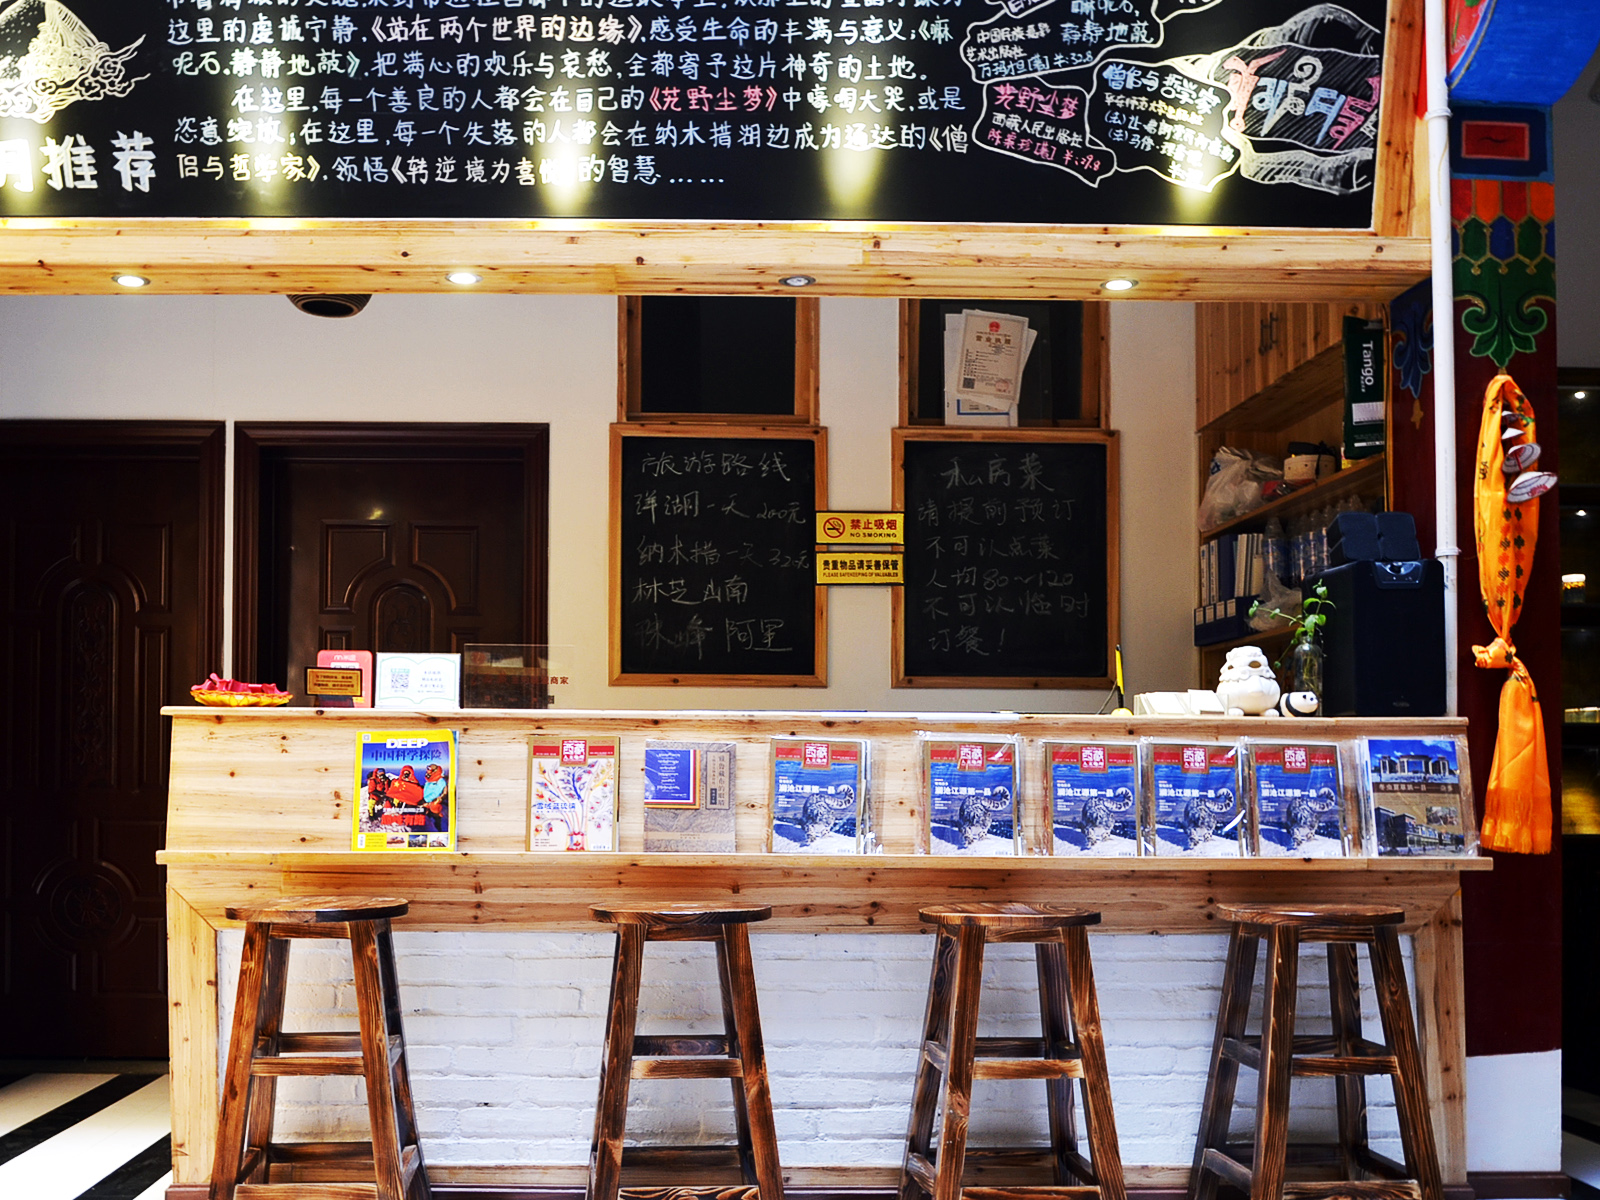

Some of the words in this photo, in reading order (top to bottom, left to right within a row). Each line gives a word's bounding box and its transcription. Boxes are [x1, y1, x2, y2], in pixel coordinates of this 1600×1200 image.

[1362, 340, 1375, 386] Tango
[642, 451, 791, 481] 旅游路线
[940, 454, 1055, 491] 私房菜
[850, 519, 897, 530] 禁止吸烟
[918, 497, 1075, 527] 请提前预订
[925, 533, 1060, 560] 不可以点菜
[823, 559, 898, 570] 贵重物品请妥善保管
[386, 738, 428, 748] DEEP
